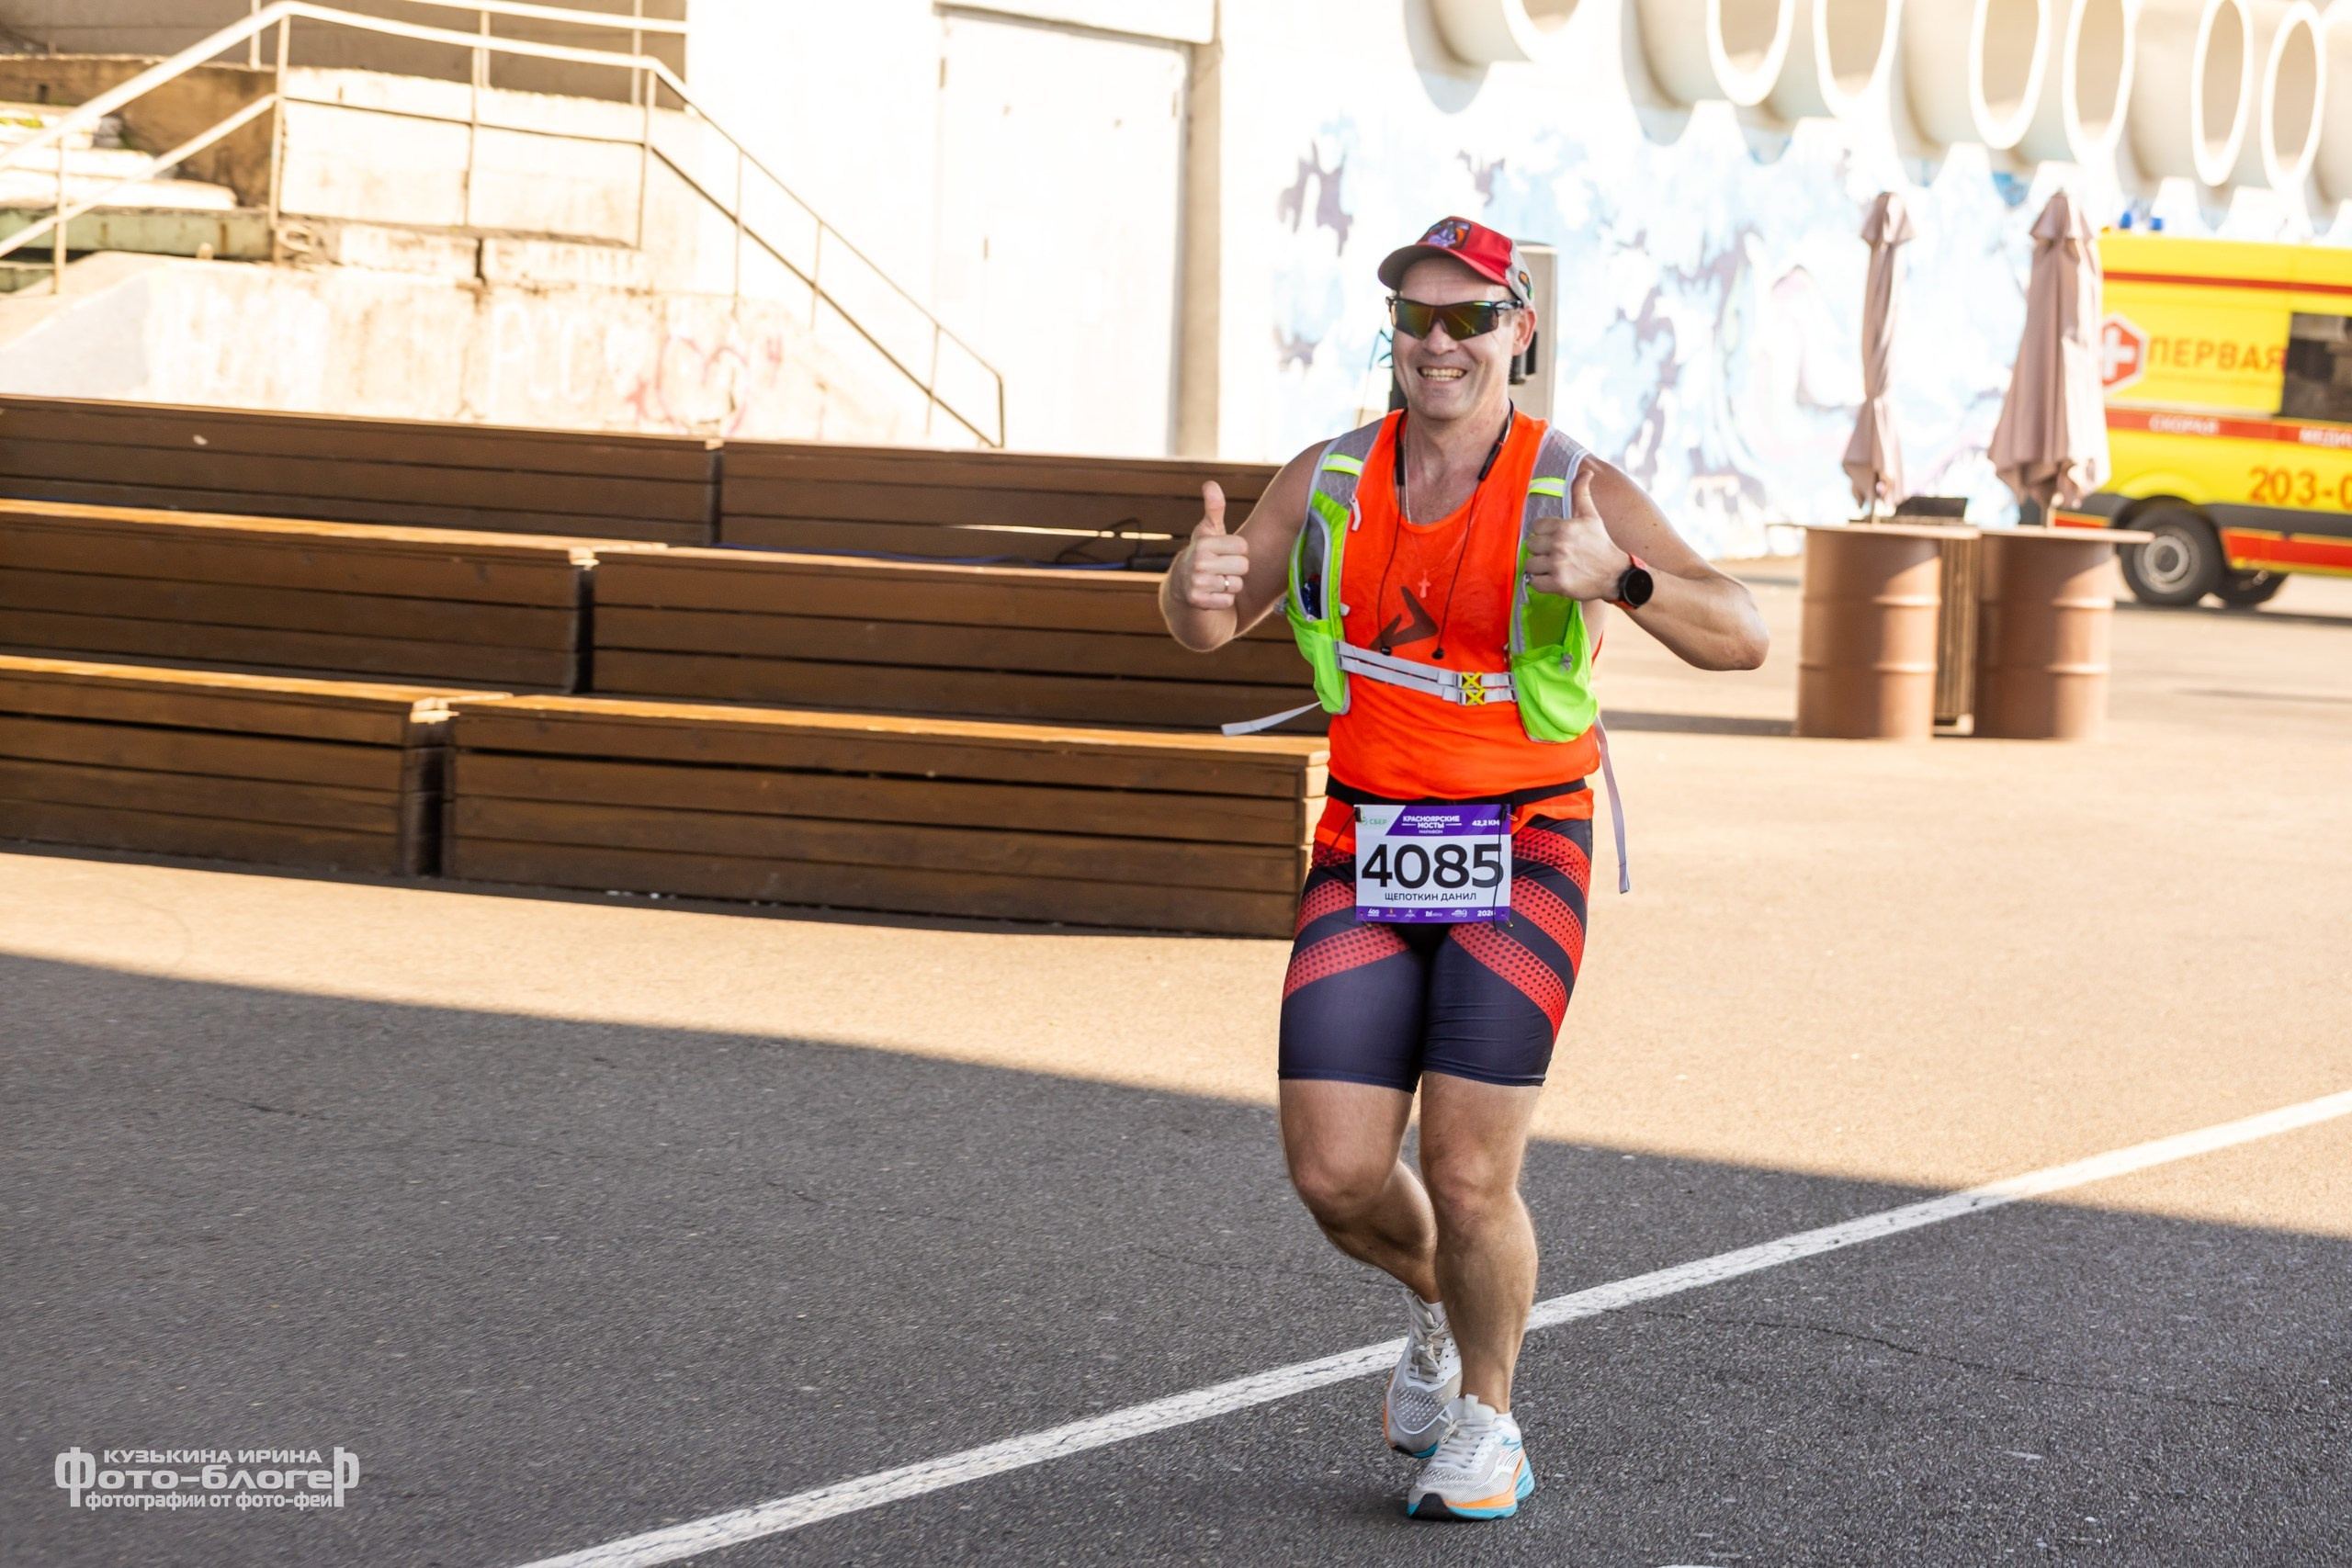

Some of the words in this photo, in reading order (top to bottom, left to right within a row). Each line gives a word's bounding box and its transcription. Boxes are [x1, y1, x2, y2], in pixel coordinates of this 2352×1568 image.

[2148, 336, 2287, 373] ПЕРВАЯ
[1369, 818, 1387, 826] СБЕР
[1362, 843, 1504, 889] 4085
[1385, 893, 1439, 901] ЩЕПОТКИН
[1441, 893, 1476, 901] ДАНИЛ
